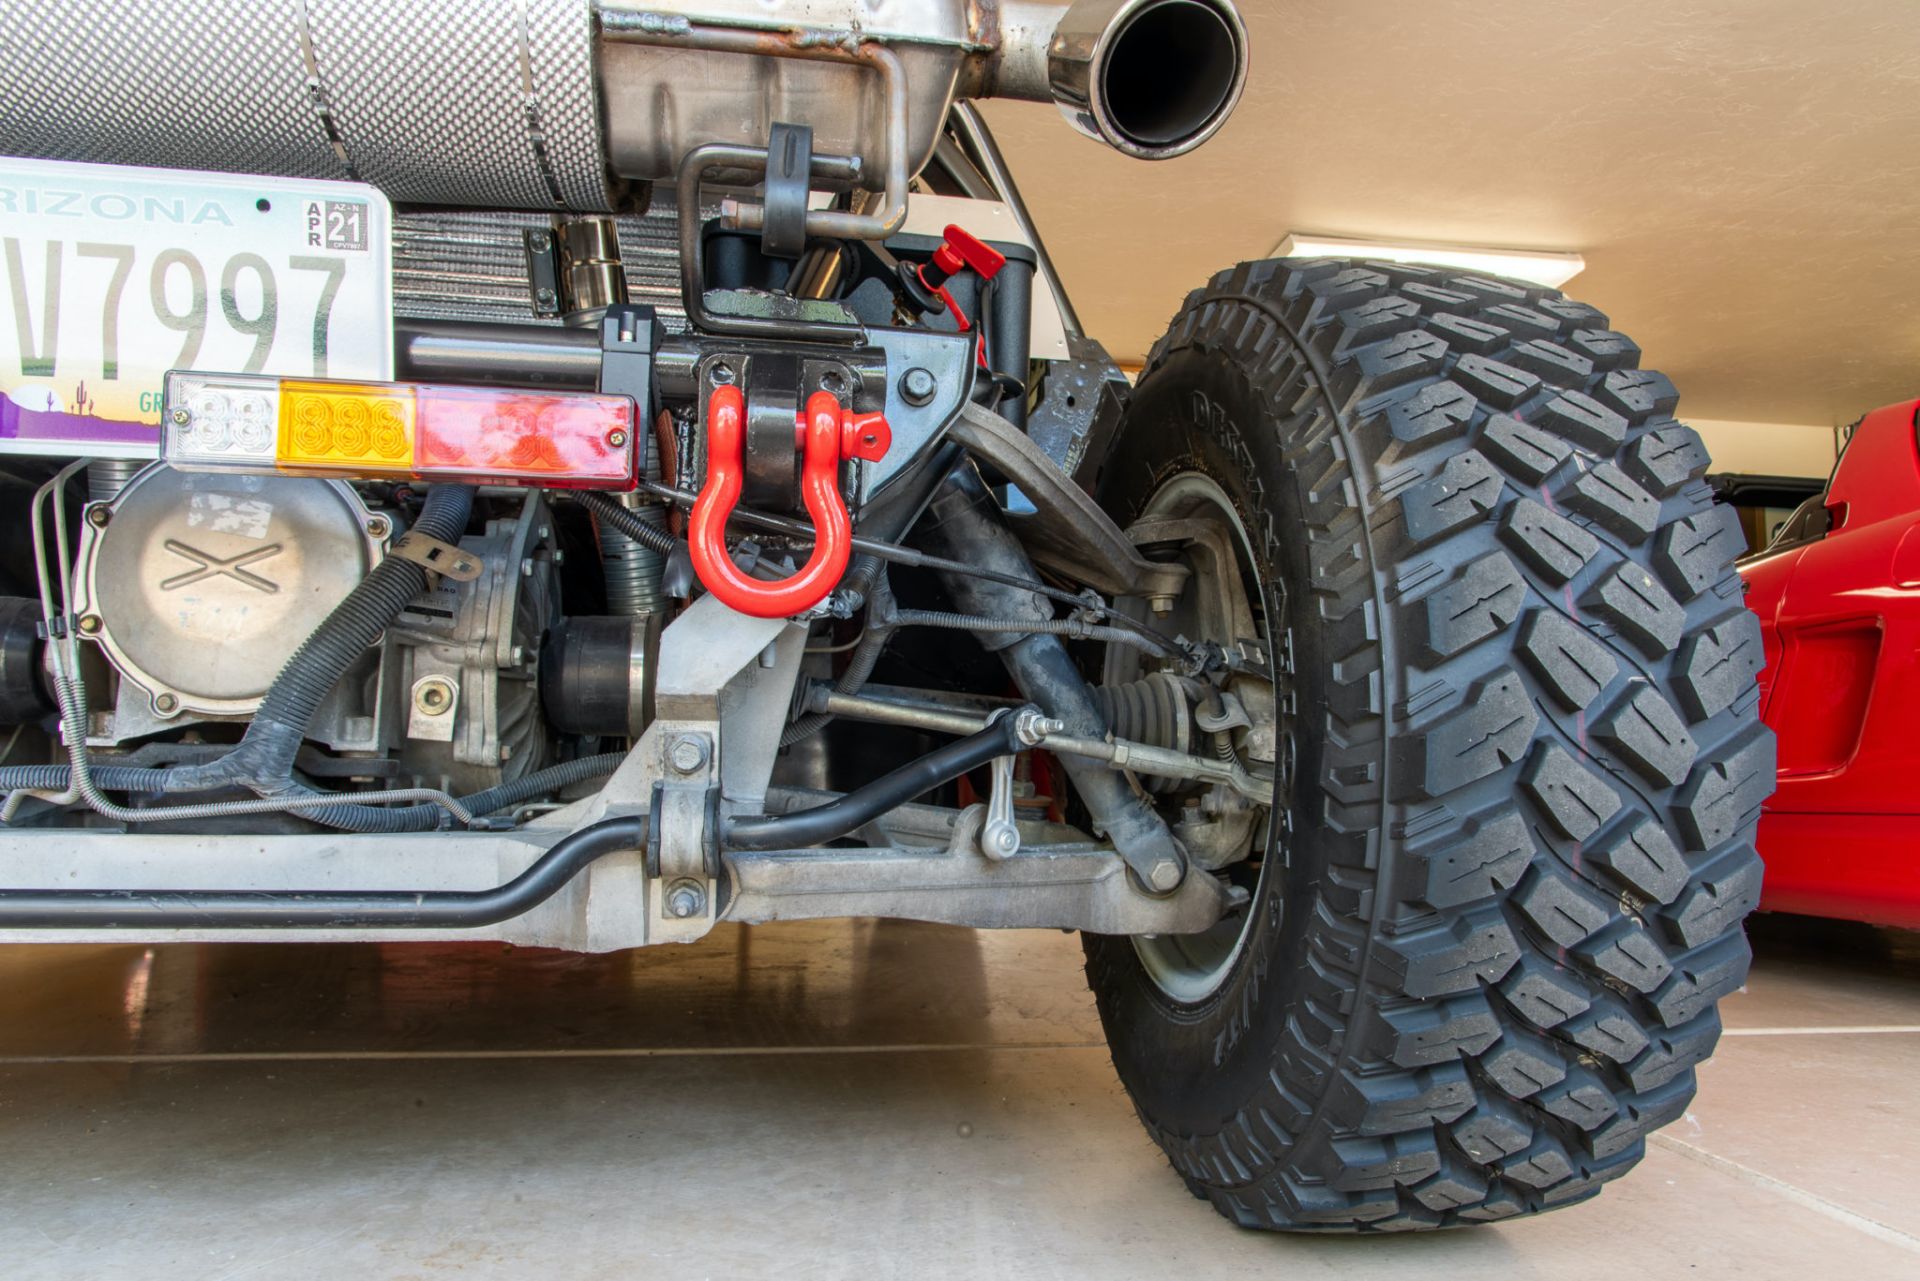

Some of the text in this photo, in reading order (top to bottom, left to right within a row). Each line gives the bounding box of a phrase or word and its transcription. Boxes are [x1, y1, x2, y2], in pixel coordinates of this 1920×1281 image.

[307, 202, 322, 247] APR
[328, 211, 360, 243] 21
[3, 236, 347, 381] V7997
